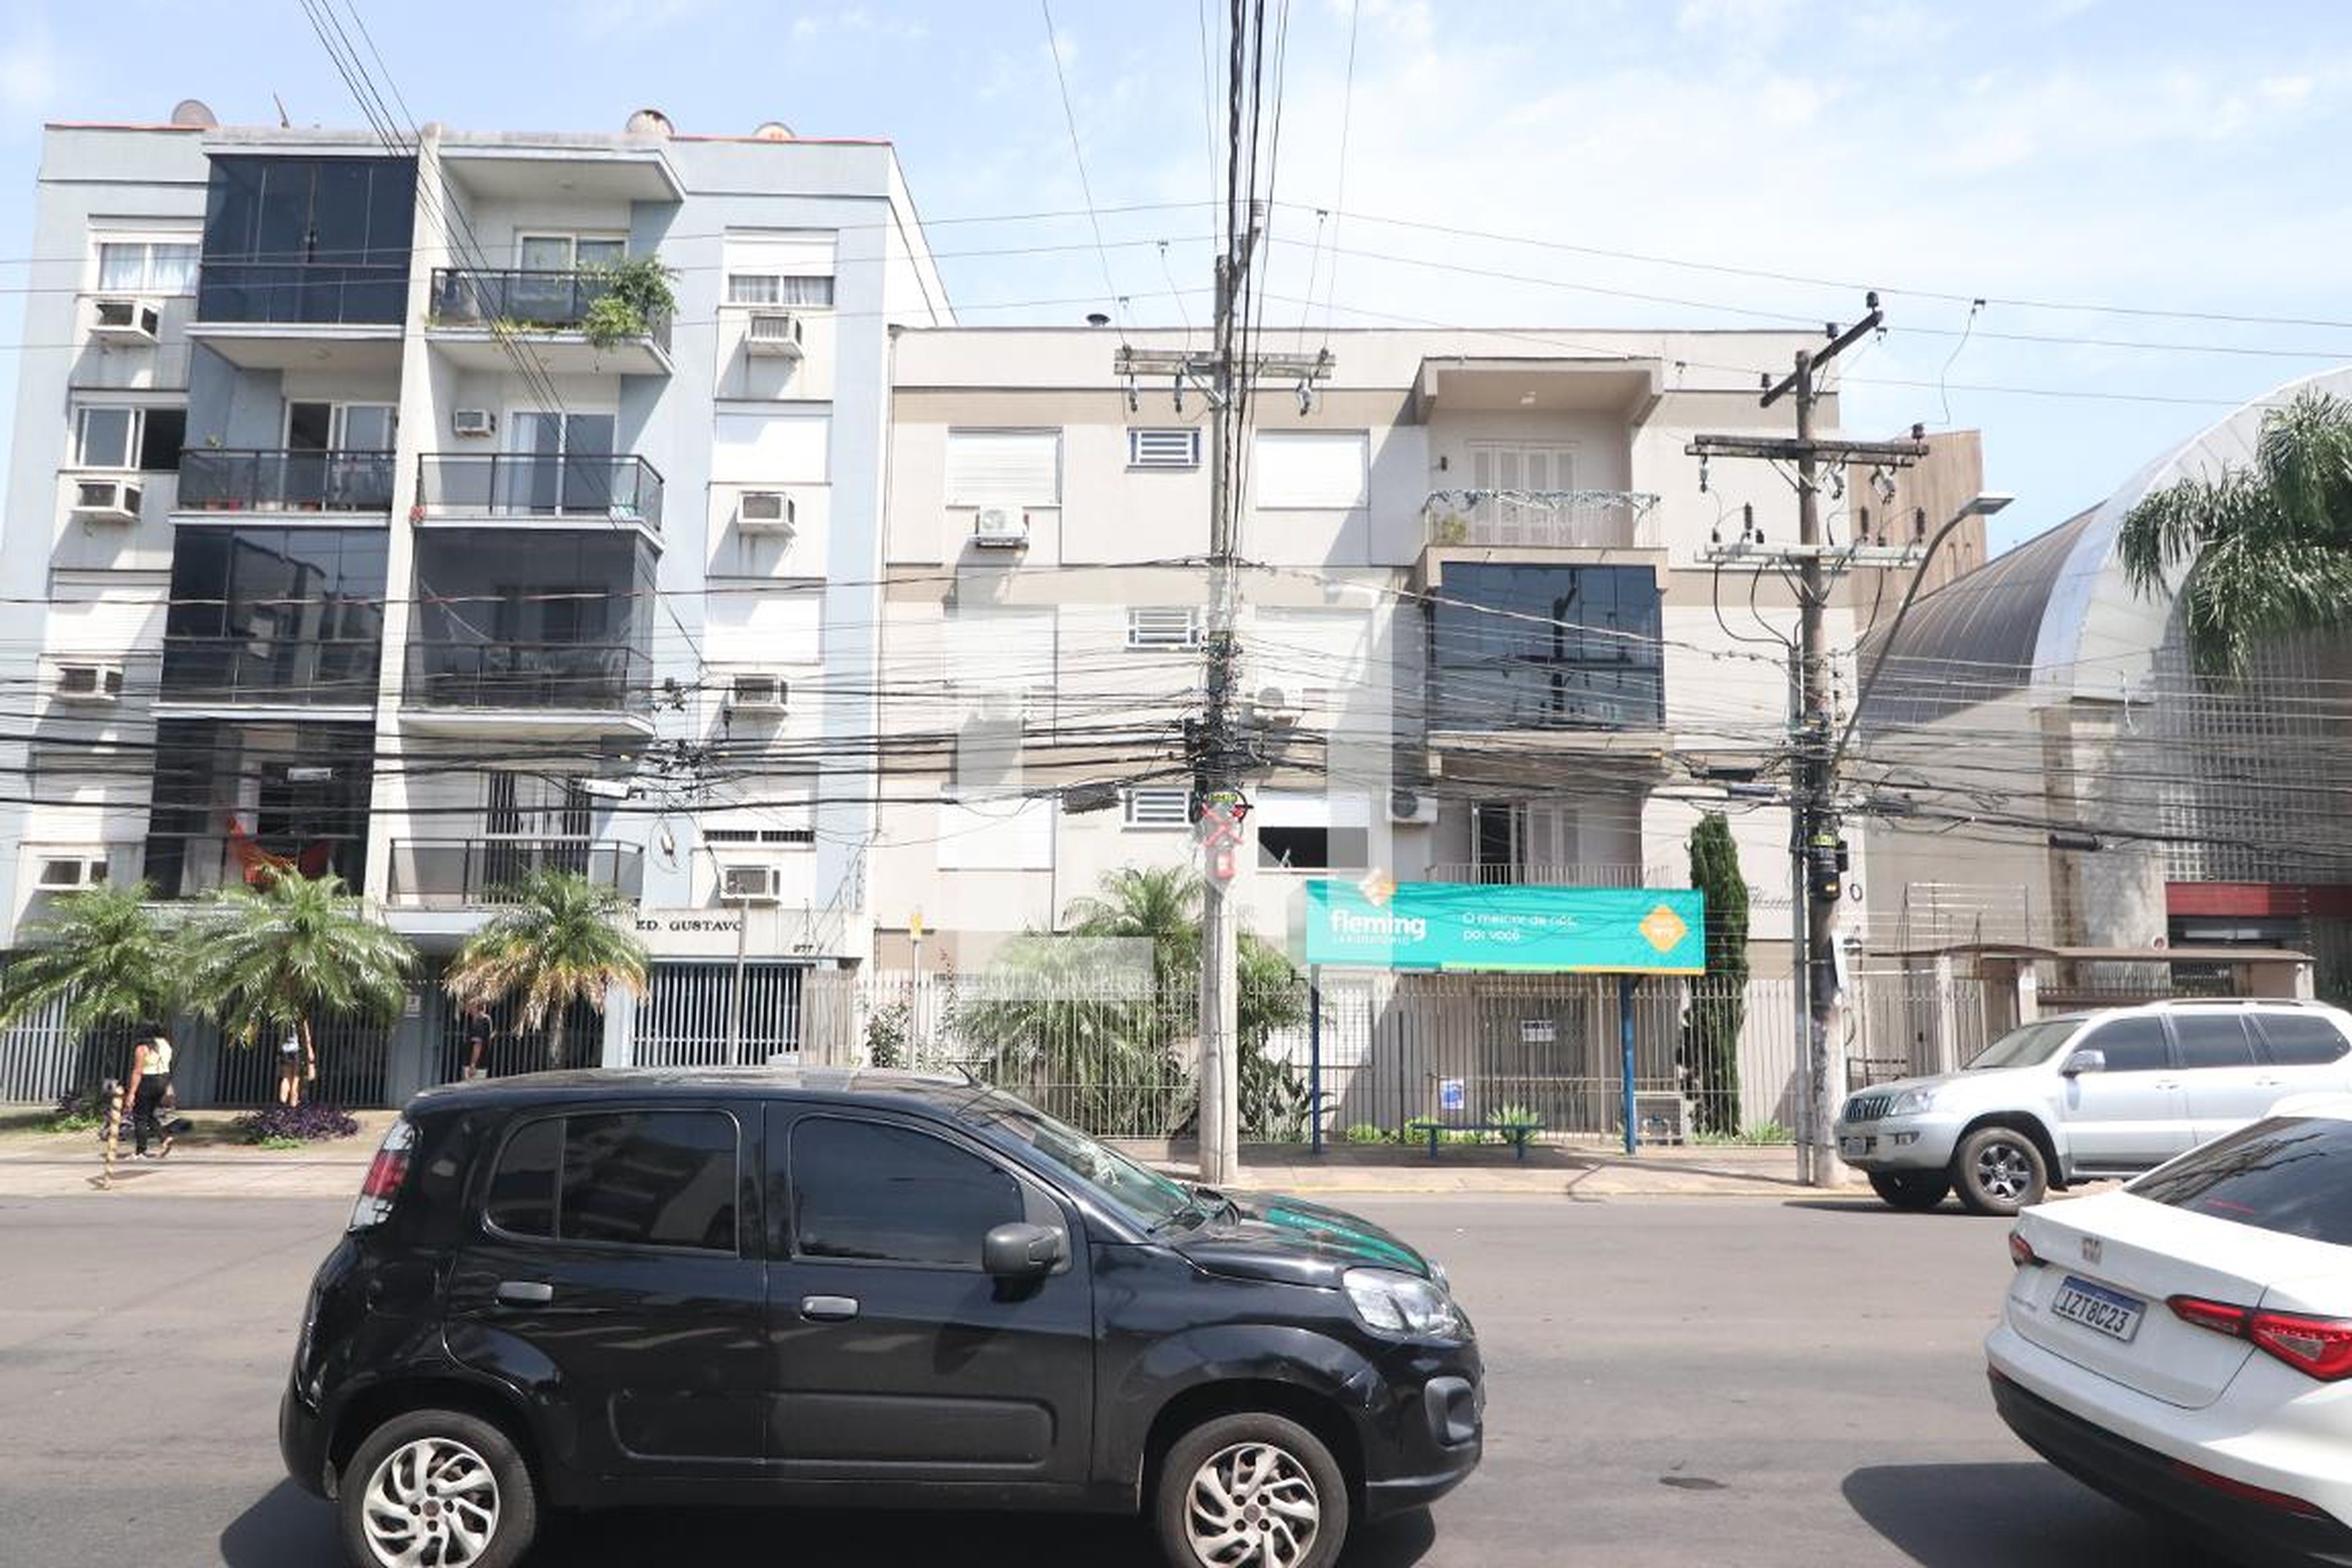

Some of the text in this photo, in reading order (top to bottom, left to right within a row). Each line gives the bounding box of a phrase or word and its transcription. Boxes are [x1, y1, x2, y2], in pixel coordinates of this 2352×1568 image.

[1331, 908, 1426, 941] fleming
[1463, 913, 1474, 924] O
[2060, 1291, 2130, 1333] IZT8C23
